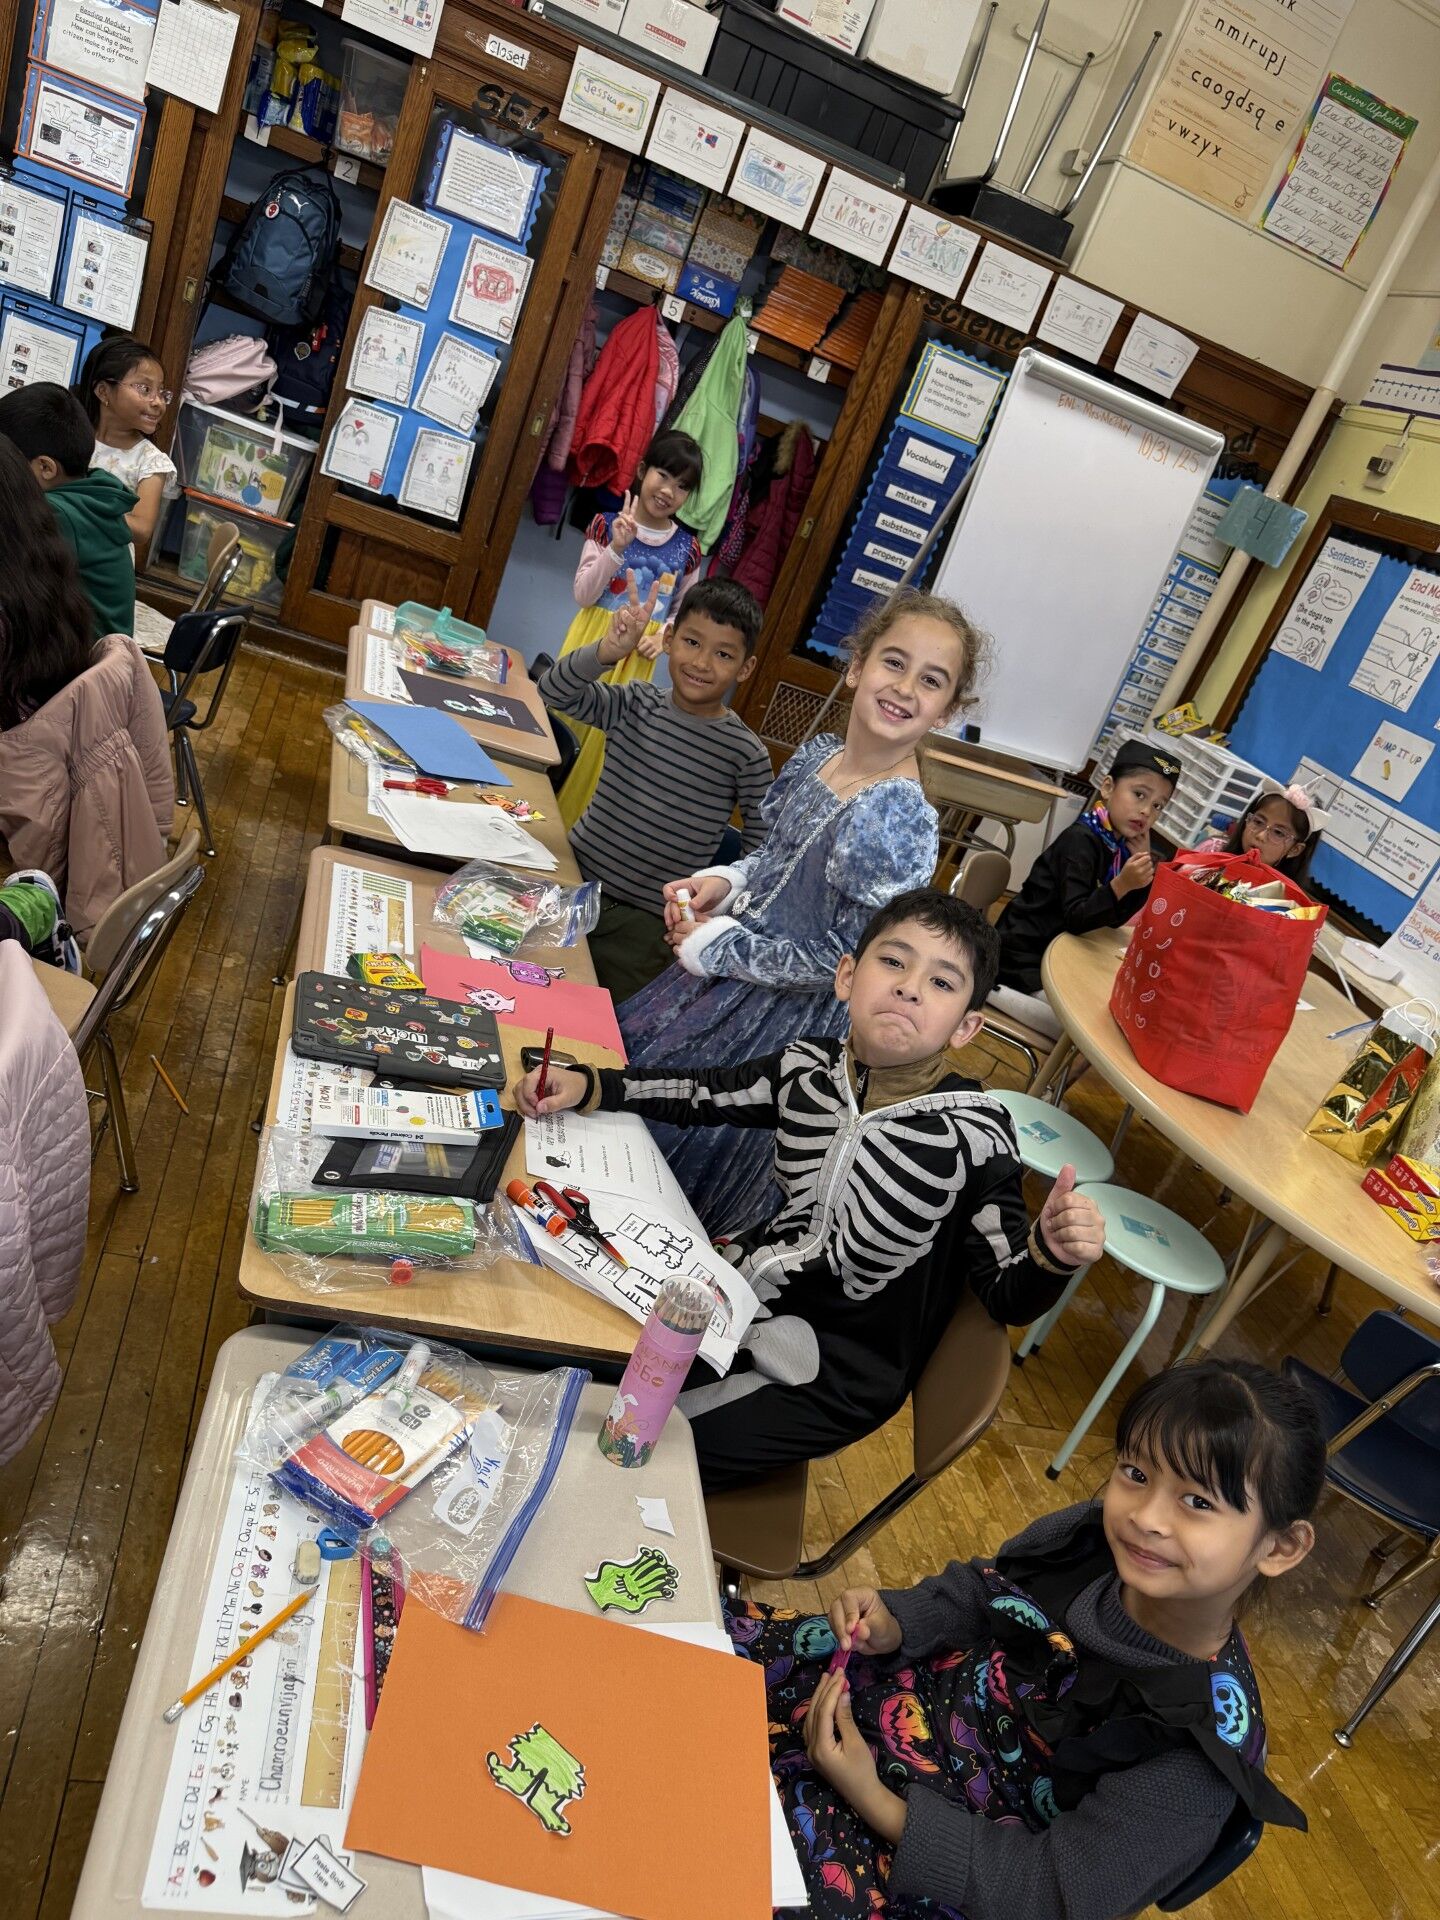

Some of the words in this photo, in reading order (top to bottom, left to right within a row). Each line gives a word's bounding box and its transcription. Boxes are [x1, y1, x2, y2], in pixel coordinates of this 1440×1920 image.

[75, 14, 102, 30] Essential
[80, 6, 104, 21] Reading
[105, 17, 127, 31] Module
[71, 22, 85, 32] How
[85, 29, 96, 37] can
[97, 33, 113, 46] being
[119, 43, 134, 53] good
[62, 29, 84, 41] citizen
[84, 38, 100, 49] make
[106, 47, 139, 65] difference
[488, 40, 527, 66] Closet
[91, 50, 116, 64] others?
[1331, 81, 1366, 108] Cursive
[1366, 102, 1407, 130] Alphabet
[341, 159, 355, 178] 2
[690, 287, 721, 308] Kleenex
[668, 300, 680, 316] 5
[815, 362, 827, 377] 7
[935, 367, 948, 379] Unit
[948, 373, 974, 388] Question
[931, 378, 944, 389] How
[944, 384, 956, 393] can
[955, 388, 967, 398] you
[966, 392, 985, 406] design
[932, 389, 955, 403] mixture
[954, 398, 964, 406] for
[924, 396, 944, 409] certain
[943, 404, 970, 418] purpose?
[906, 448, 949, 473] Vocabulary
[895, 490, 927, 508] mixture
[880, 519, 922, 540] substance
[871, 547, 908, 567] property
[1327, 547, 1367, 569] Sentences
[856, 574, 896, 592] ingredien
[1197, 572, 1219, 587] glob
[1409, 578, 1427, 594] End
[1300, 617, 1311, 627] the
[1308, 608, 1323, 622] dogs
[1323, 614, 1334, 625] ran
[1373, 736, 1398, 753] BUMP
[1396, 748, 1410, 760] IT
[1409, 755, 1422, 765] UP
[1354, 802, 1365, 813] Level
[1404, 836, 1415, 846] Level
[1403, 849, 1425, 864] supermarket
[1400, 927, 1423, 949] because
[1424, 944, 1434, 955] I
[379, 1026, 428, 1044] LUCKY
[368, 1130, 390, 1138] Pencils
[390, 1131, 413, 1139] Colored
[376, 1356, 395, 1374] Eraser
[399, 1412, 423, 1430] HB
[317, 1458, 365, 1492] SHARPENED
[234, 1546, 253, 1558] Pp
[231, 1562, 245, 1578] Oo
[226, 1580, 241, 1595] Nn
[222, 1598, 238, 1616] Mm
[216, 1636, 230, 1648] Kk
[203, 1691, 220, 1708] Hh
[199, 1714, 221, 1734] Gg
[188, 1764, 205, 1780] Ee
[184, 1786, 201, 1804] Dd
[174, 1839, 190, 1857] Bb
[168, 1866, 185, 1886] Aa
[311, 1853, 329, 1871] Paste
[328, 1867, 347, 1890] Body
[313, 1868, 329, 1888] Here
